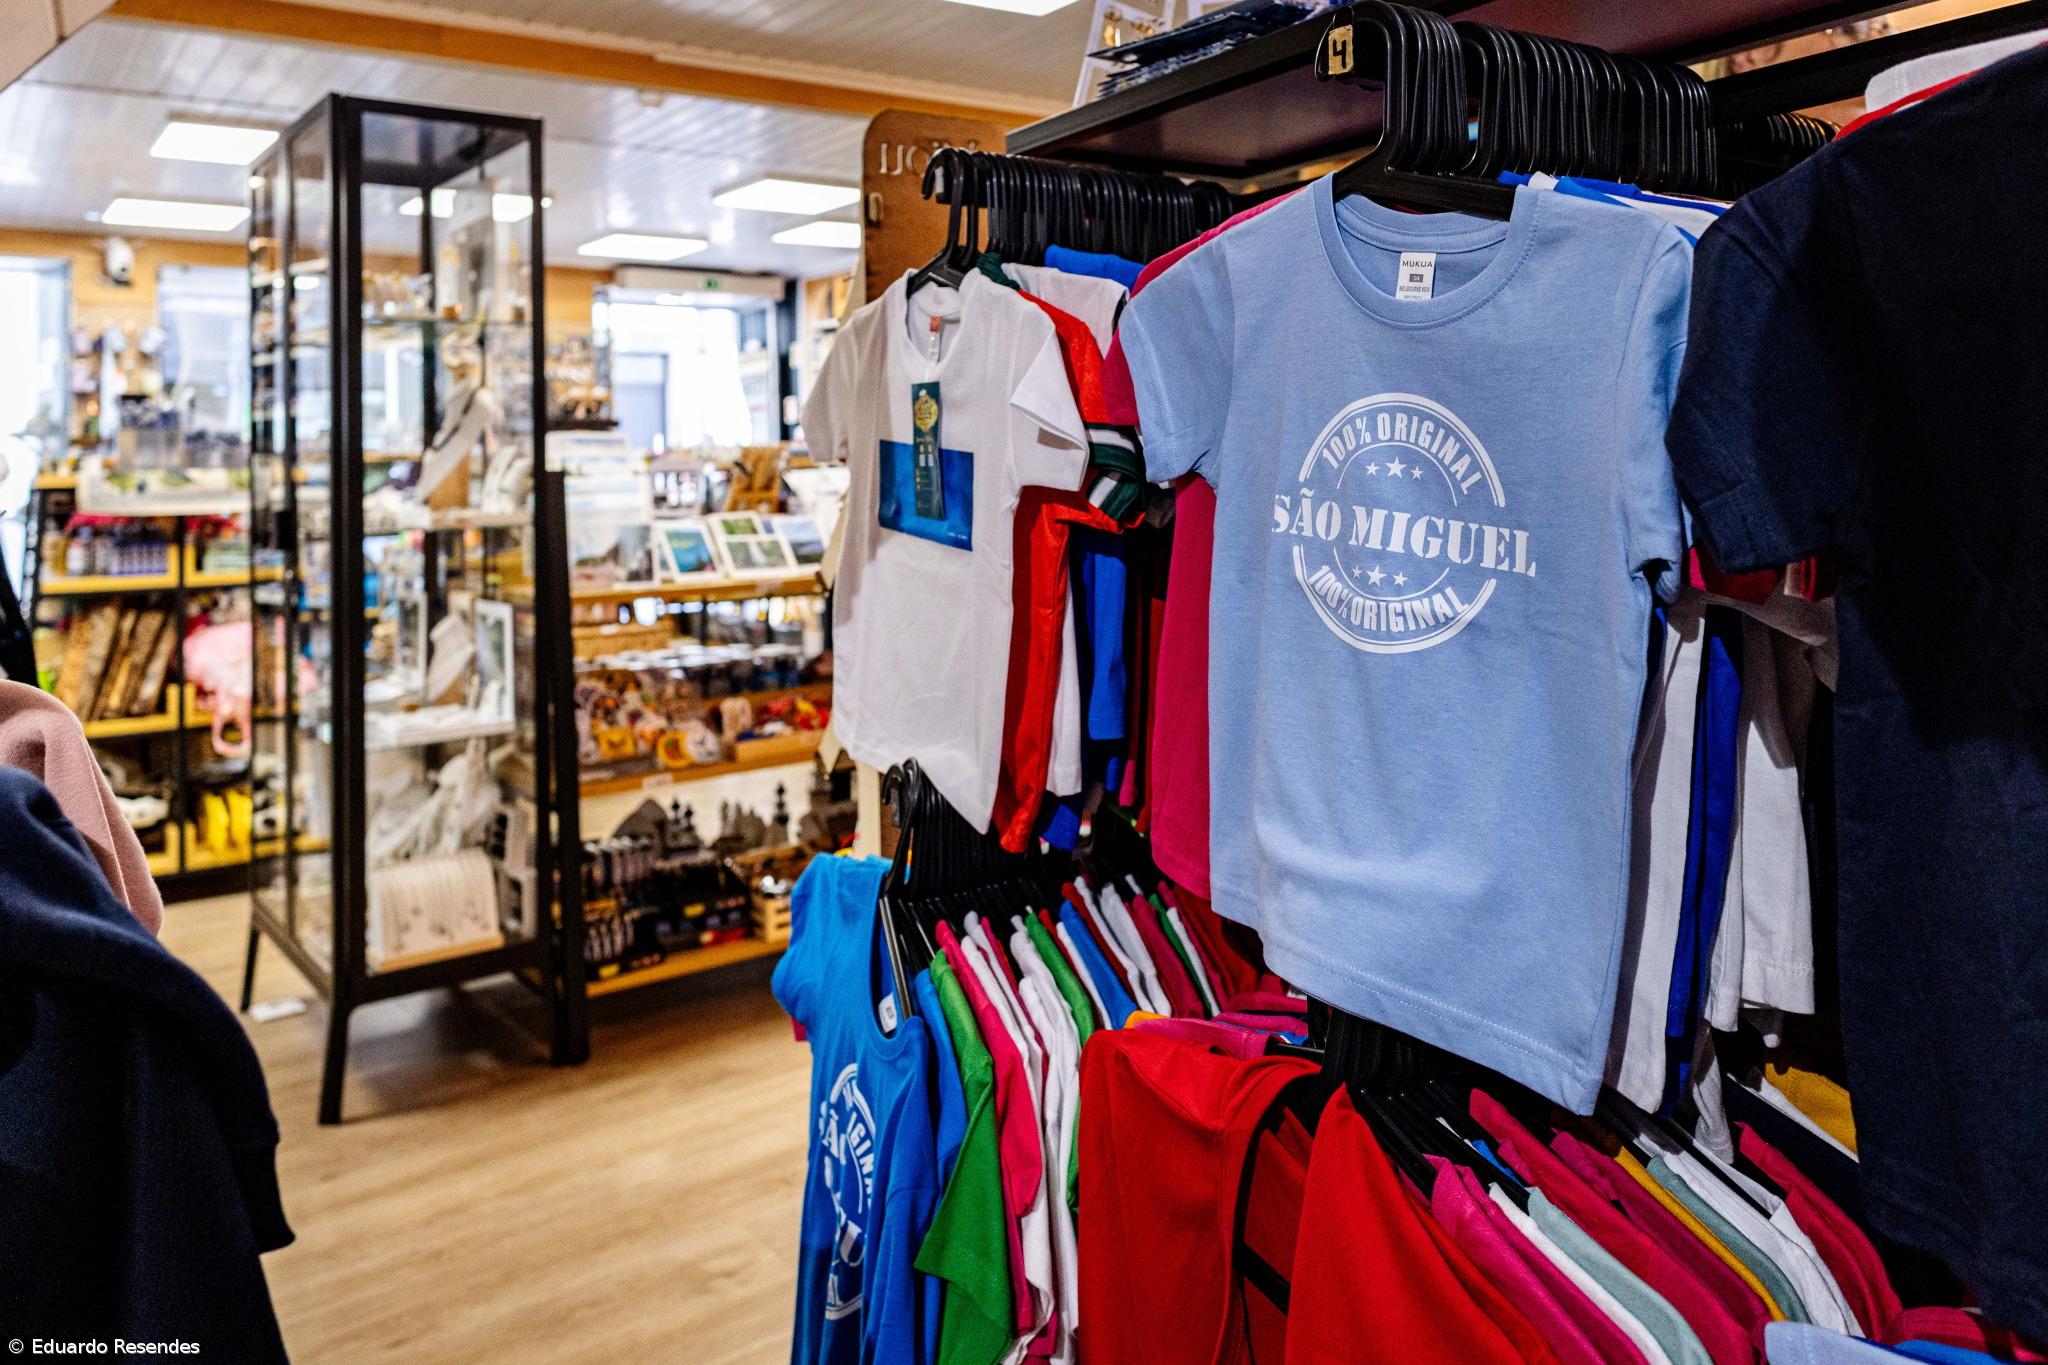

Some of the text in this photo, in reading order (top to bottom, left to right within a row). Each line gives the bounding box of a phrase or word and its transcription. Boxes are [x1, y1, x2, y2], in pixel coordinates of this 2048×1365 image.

[1332, 39, 1347, 69] 4
[1402, 260, 1433, 268] MUKUA
[1322, 412, 1482, 495] 100% ORIGINAL
[1271, 487, 1537, 578] SÃO MIGUEL
[1308, 565, 1469, 633] 100% ORIGINAL
